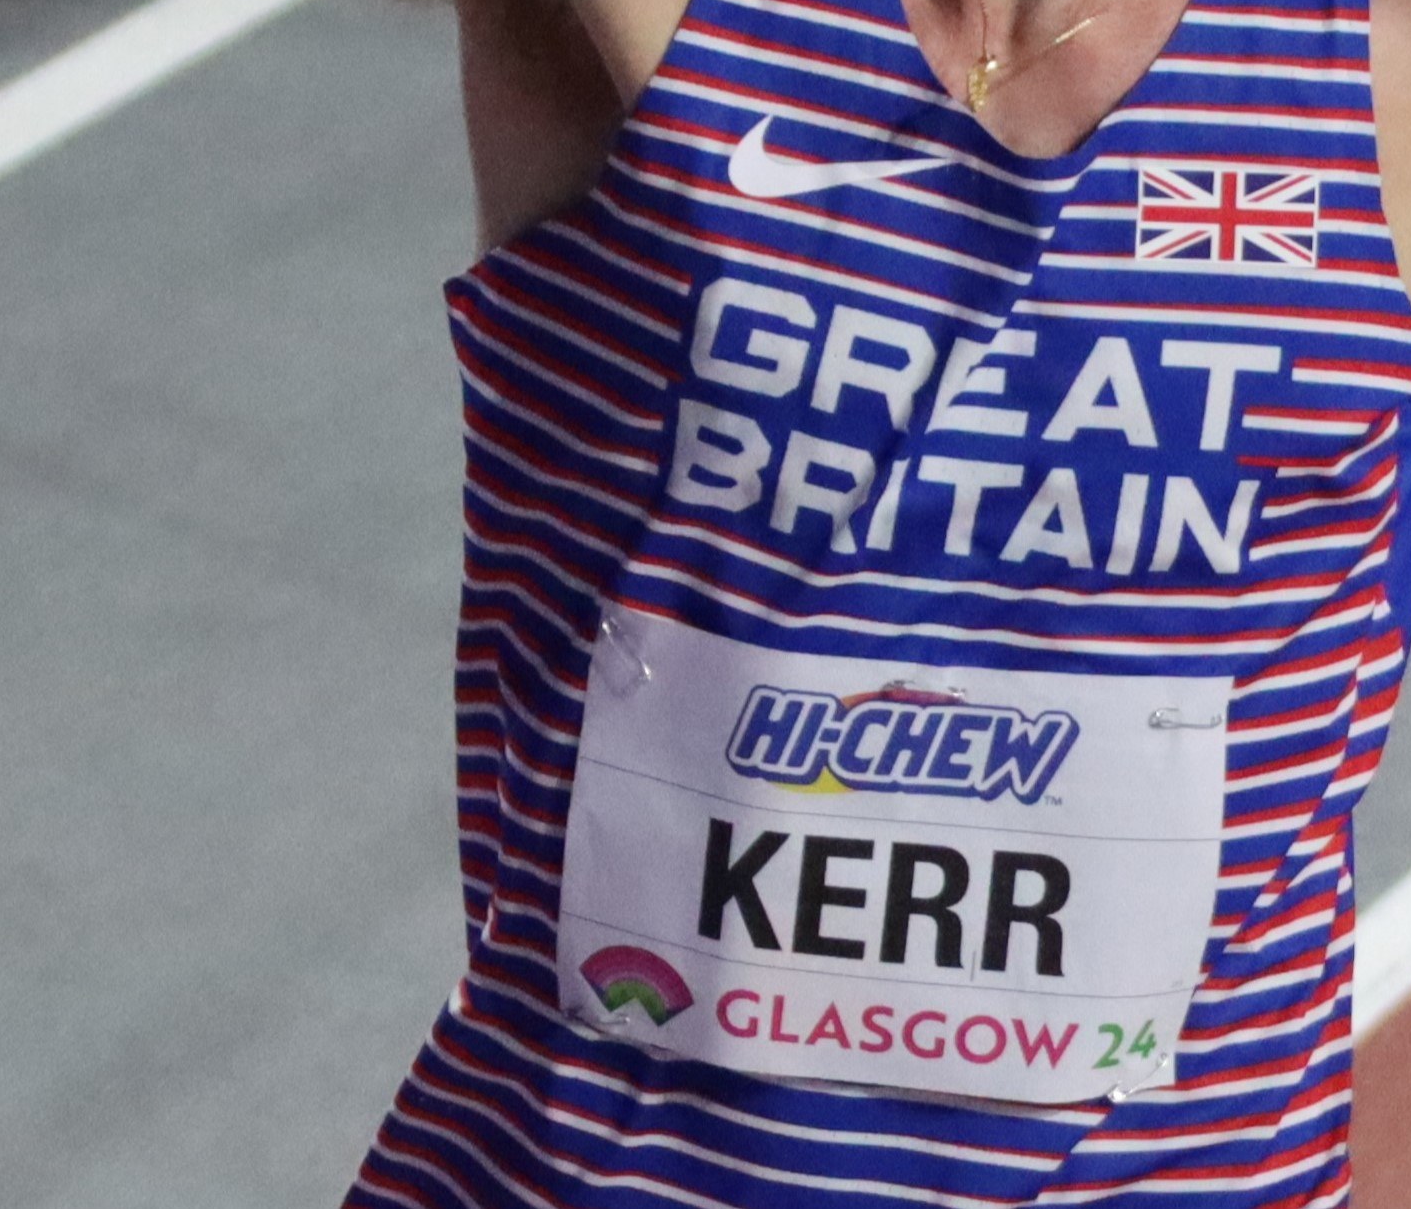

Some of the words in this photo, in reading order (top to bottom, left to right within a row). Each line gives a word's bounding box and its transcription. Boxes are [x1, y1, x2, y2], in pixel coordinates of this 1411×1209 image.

[690, 277, 1282, 452] GREAT
[666, 398, 1261, 576] BRITAIN
[728, 686, 1078, 803] HI-CHEW
[697, 817, 1071, 977] KERR
[716, 989, 1079, 1070] GLASGOW
[1092, 1018, 1157, 1070] 24
